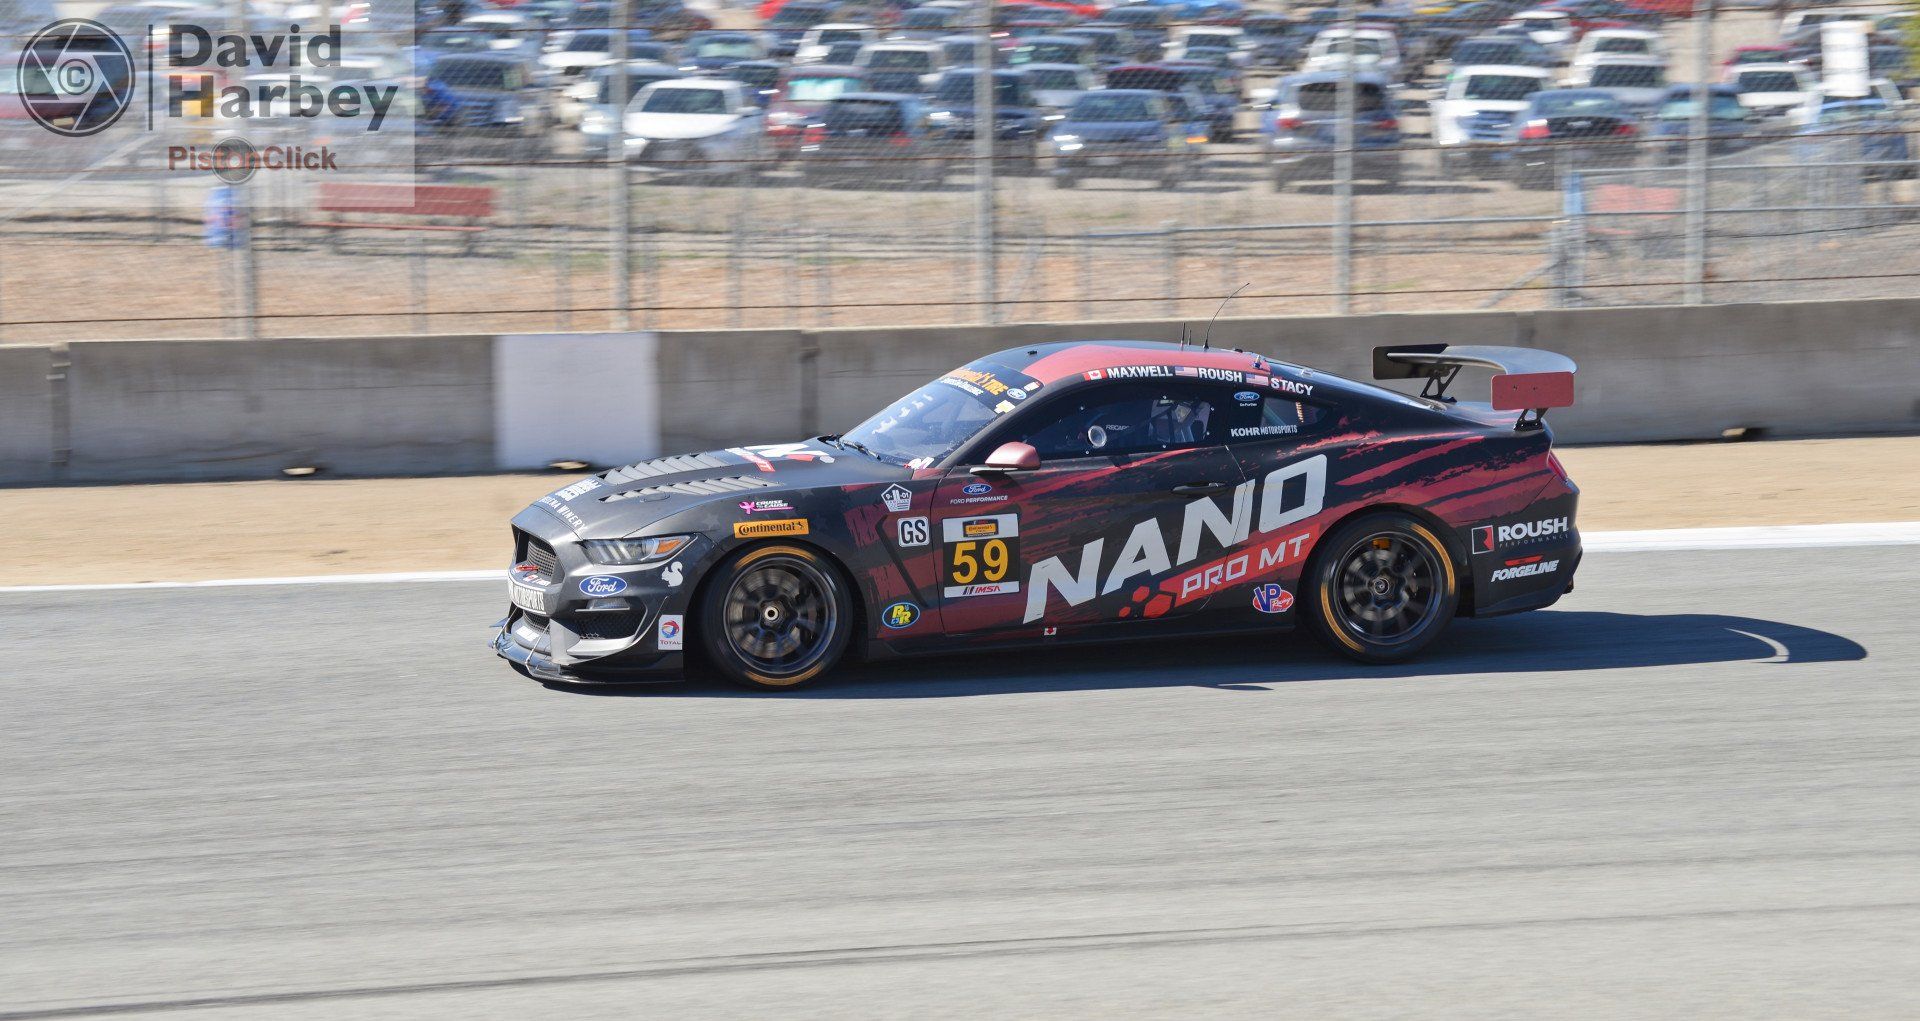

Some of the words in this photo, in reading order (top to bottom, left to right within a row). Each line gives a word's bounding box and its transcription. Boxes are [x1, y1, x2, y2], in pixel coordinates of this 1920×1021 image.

[1106, 366, 1173, 379] MAXWELL
[1198, 367, 1242, 383] ROUSH
[1270, 378, 1314, 396] STACY
[1231, 427, 1260, 437] KOHR
[1260, 424, 1298, 436] MOTORSPORTS
[966, 495, 1008, 504] PERFORMANCE
[739, 522, 795, 536] Continental
[900, 520, 926, 545] GS
[1498, 517, 1568, 542] ROUSH
[1022, 454, 1328, 625] NANO
[1500, 534, 1569, 548] PERFORMANCE
[953, 539, 1008, 584] 59
[1181, 554, 1249, 599] PRO
[1259, 533, 1311, 570] MT
[1491, 560, 1559, 582] FORGELINE
[975, 585, 1001, 594] IMSA
[1254, 584, 1282, 611] VP
